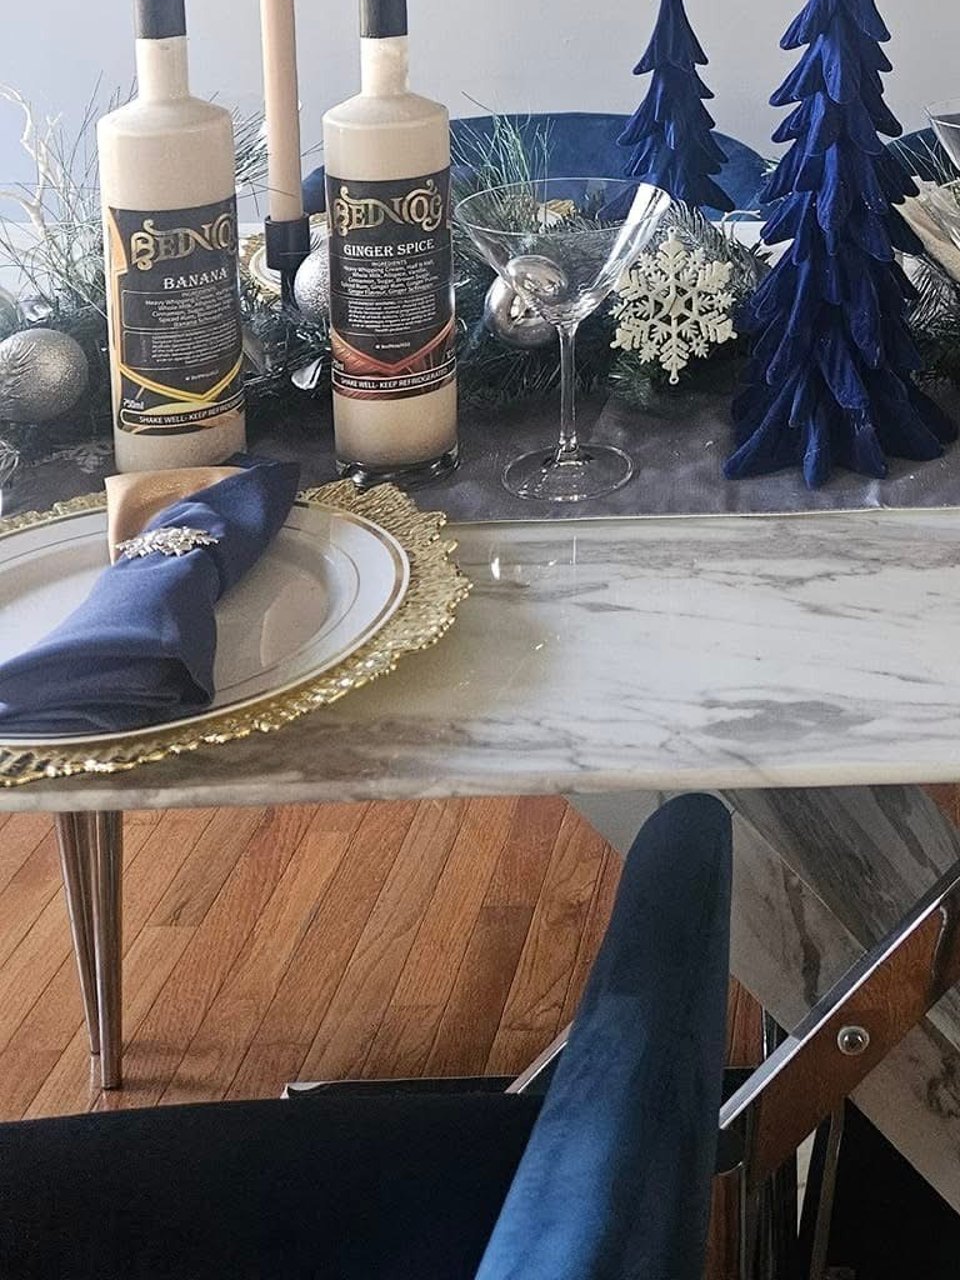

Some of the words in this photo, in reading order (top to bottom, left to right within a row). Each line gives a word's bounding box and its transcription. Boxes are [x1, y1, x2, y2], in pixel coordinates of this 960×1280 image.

[343, 244, 394, 257] GINGER
[397, 238, 435, 256] SPICE
[164, 267, 228, 289] BANANA
[379, 380, 398, 388] KEEP
[139, 415, 164, 424] SHAKE
[189, 410, 207, 421] KEEP
